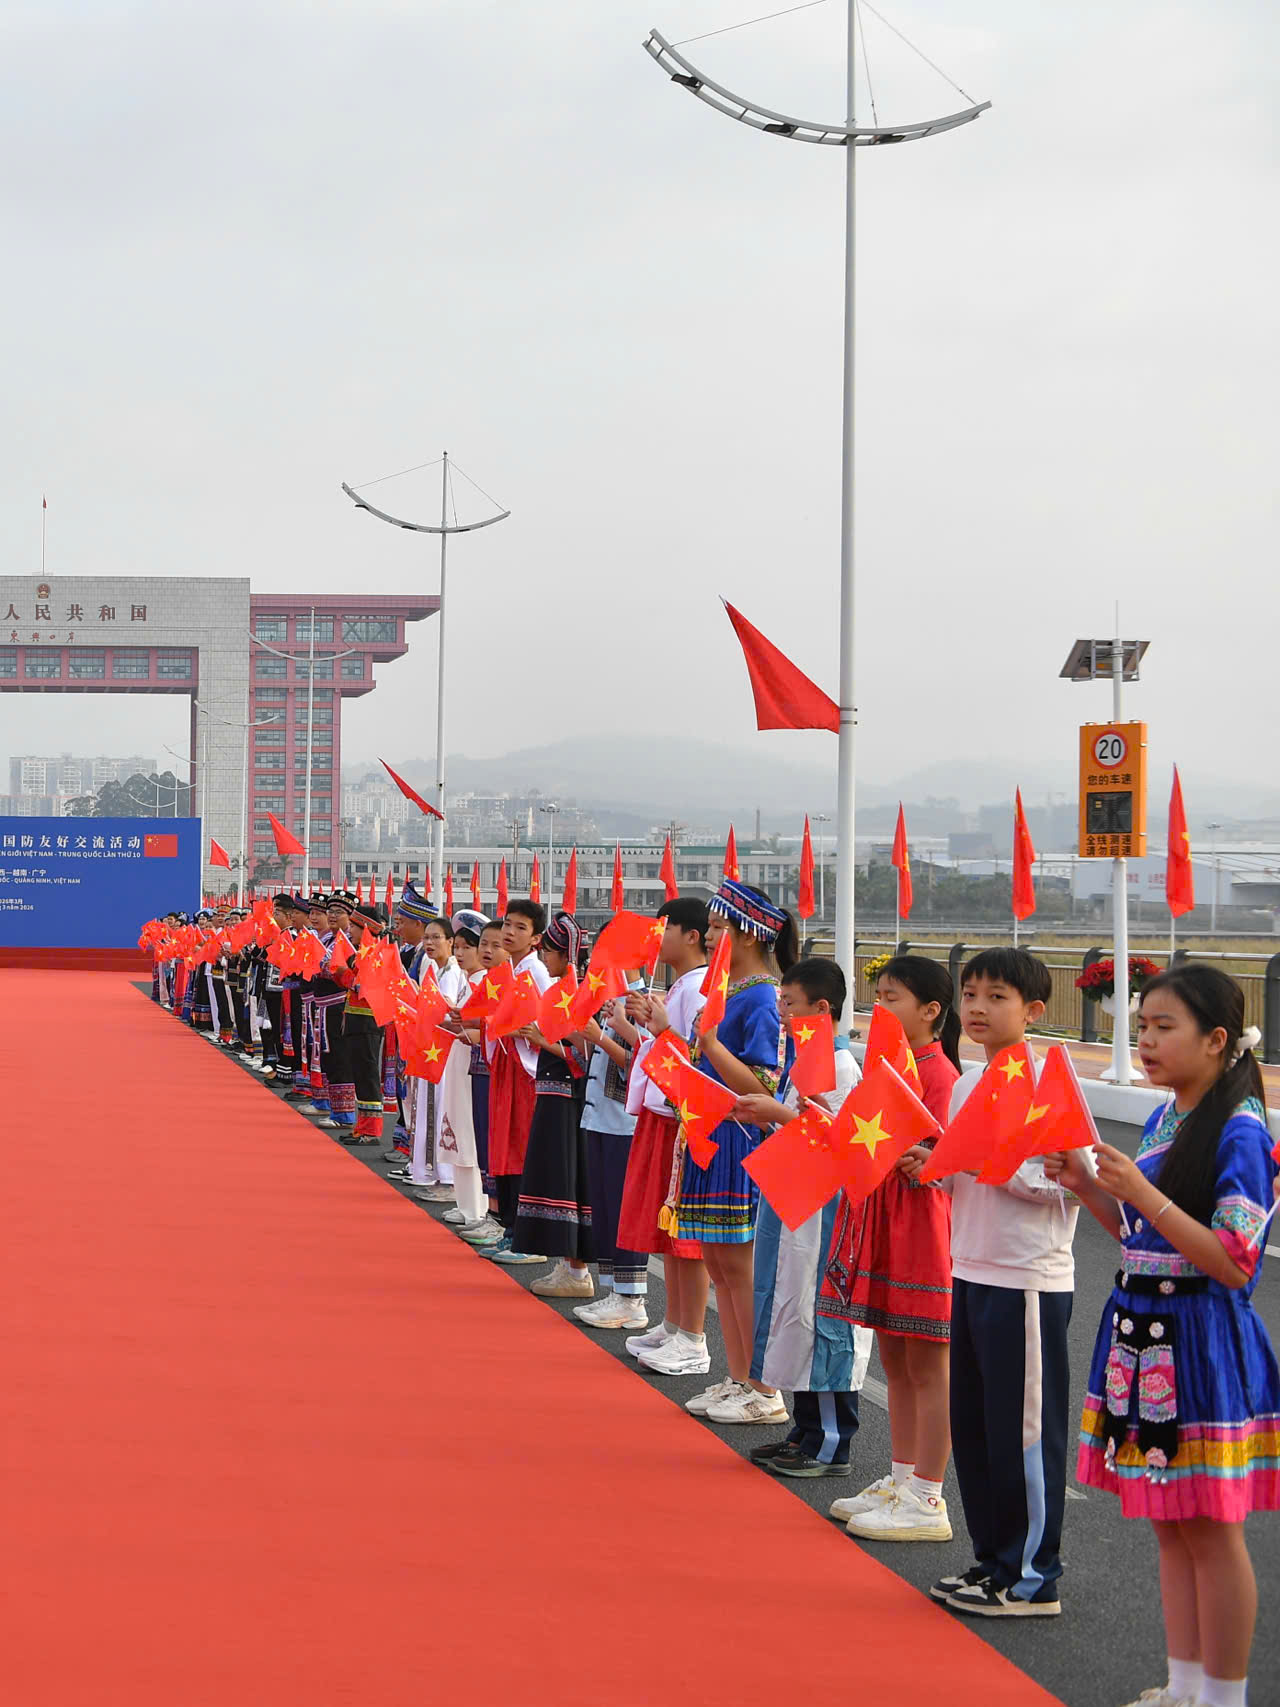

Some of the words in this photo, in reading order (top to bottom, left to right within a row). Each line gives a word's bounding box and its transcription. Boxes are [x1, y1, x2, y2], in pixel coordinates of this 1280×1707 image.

[1098, 738, 1122, 760] 20
[1087, 773, 1132, 786] 您的车速
[1086, 834, 1132, 846] 全线测速
[22, 850, 38, 859] VIỆT
[82, 850, 102, 859] QUỐC
[132, 851, 141, 859] 10
[1086, 845, 1132, 857] 请勿超速
